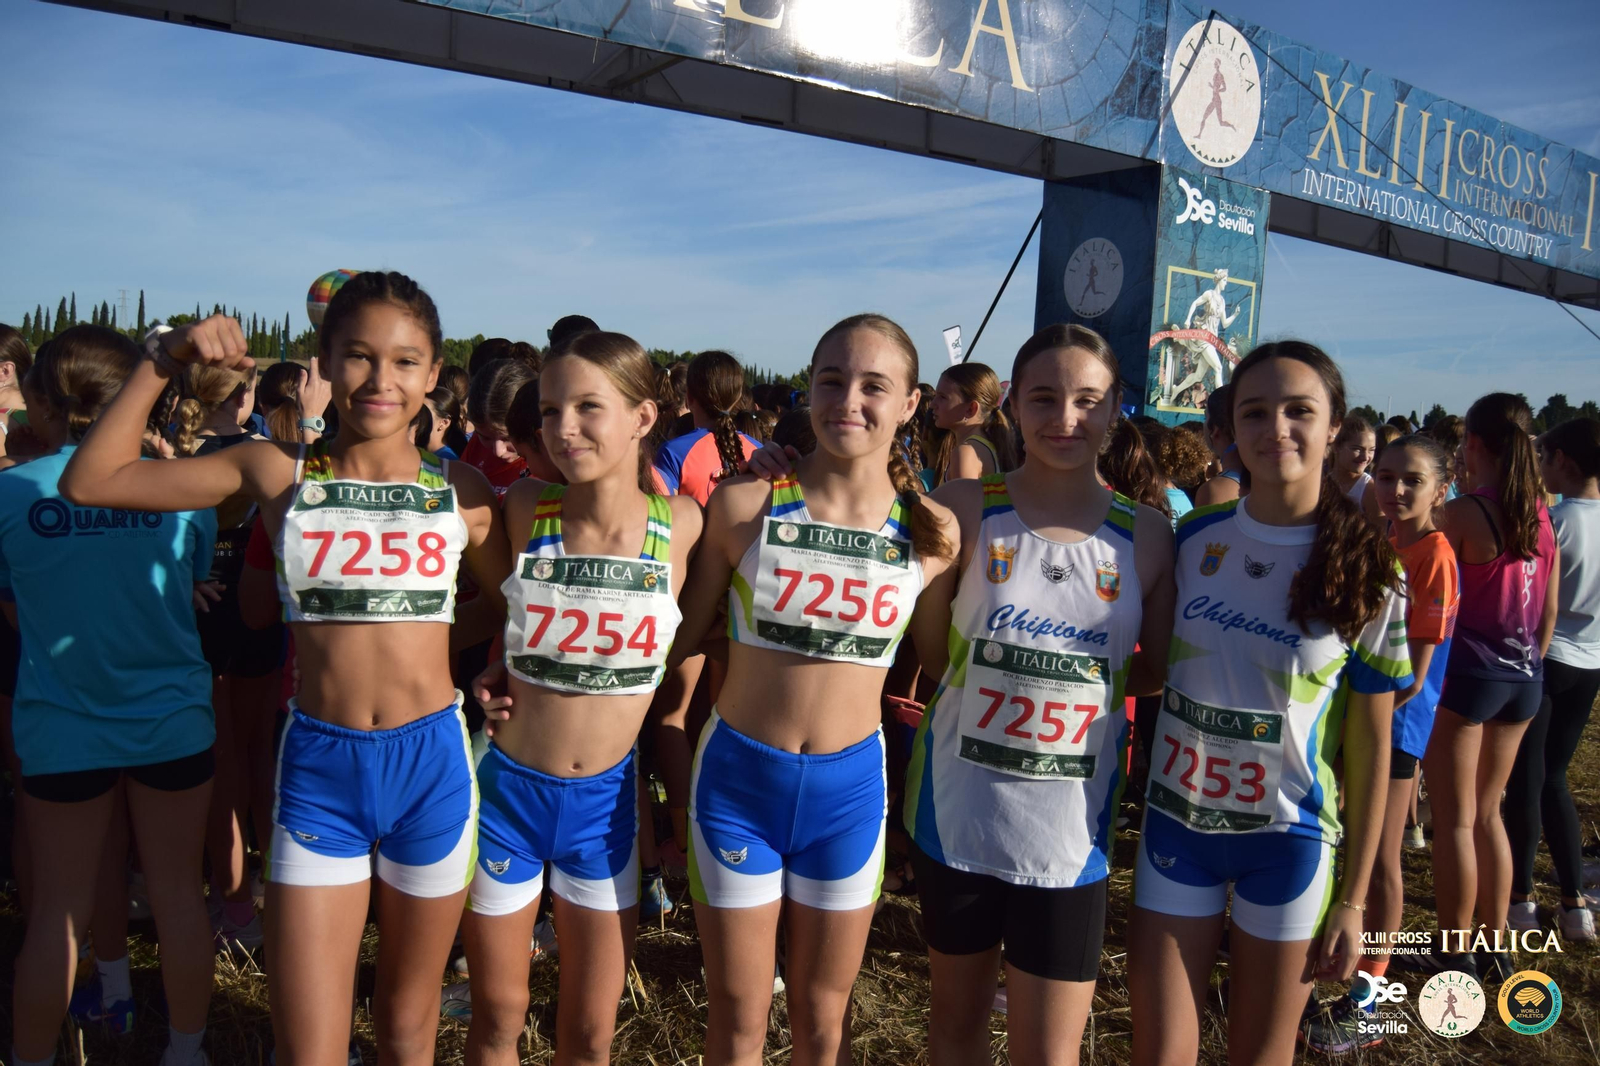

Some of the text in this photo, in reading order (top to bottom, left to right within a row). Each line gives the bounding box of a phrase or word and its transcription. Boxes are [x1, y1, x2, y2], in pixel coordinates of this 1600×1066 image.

[1179, 24, 1255, 93] ITÁLICA
[1306, 70, 1549, 200] XLIII CROSS
[1218, 212, 1255, 235] Sevilla
[1219, 199, 1255, 218] Diputación
[1301, 168, 1553, 259] INTERNATIONAL CROSS COUNTRY
[1454, 179, 1575, 238] INTERNACIONAL
[1150, 331, 1170, 346] CROSS
[338, 485, 416, 503] ITÁLICA
[28, 497, 162, 538] QUARTO
[302, 530, 447, 577] 7258
[790, 548, 811, 556] MARIA
[829, 554, 859, 564] LORENZO
[808, 528, 877, 552] ITÁLICA
[564, 559, 633, 581] ITÁLICA
[538, 582, 555, 590] LOLA
[624, 591, 654, 599] ARTEAGA
[773, 568, 899, 628] 7256
[526, 603, 658, 658] 7254
[987, 604, 1109, 646] Chipiona
[1183, 596, 1302, 648] Chipiona
[1012, 651, 1081, 674] ITÁLICA
[1003, 672, 1084, 689] ROCIO LORENZO PALACIOS
[976, 687, 1099, 744] 7257
[1184, 701, 1242, 730] ITÁLICA
[1212, 736, 1238, 745] ALCEDO
[1162, 734, 1266, 803] 7253
